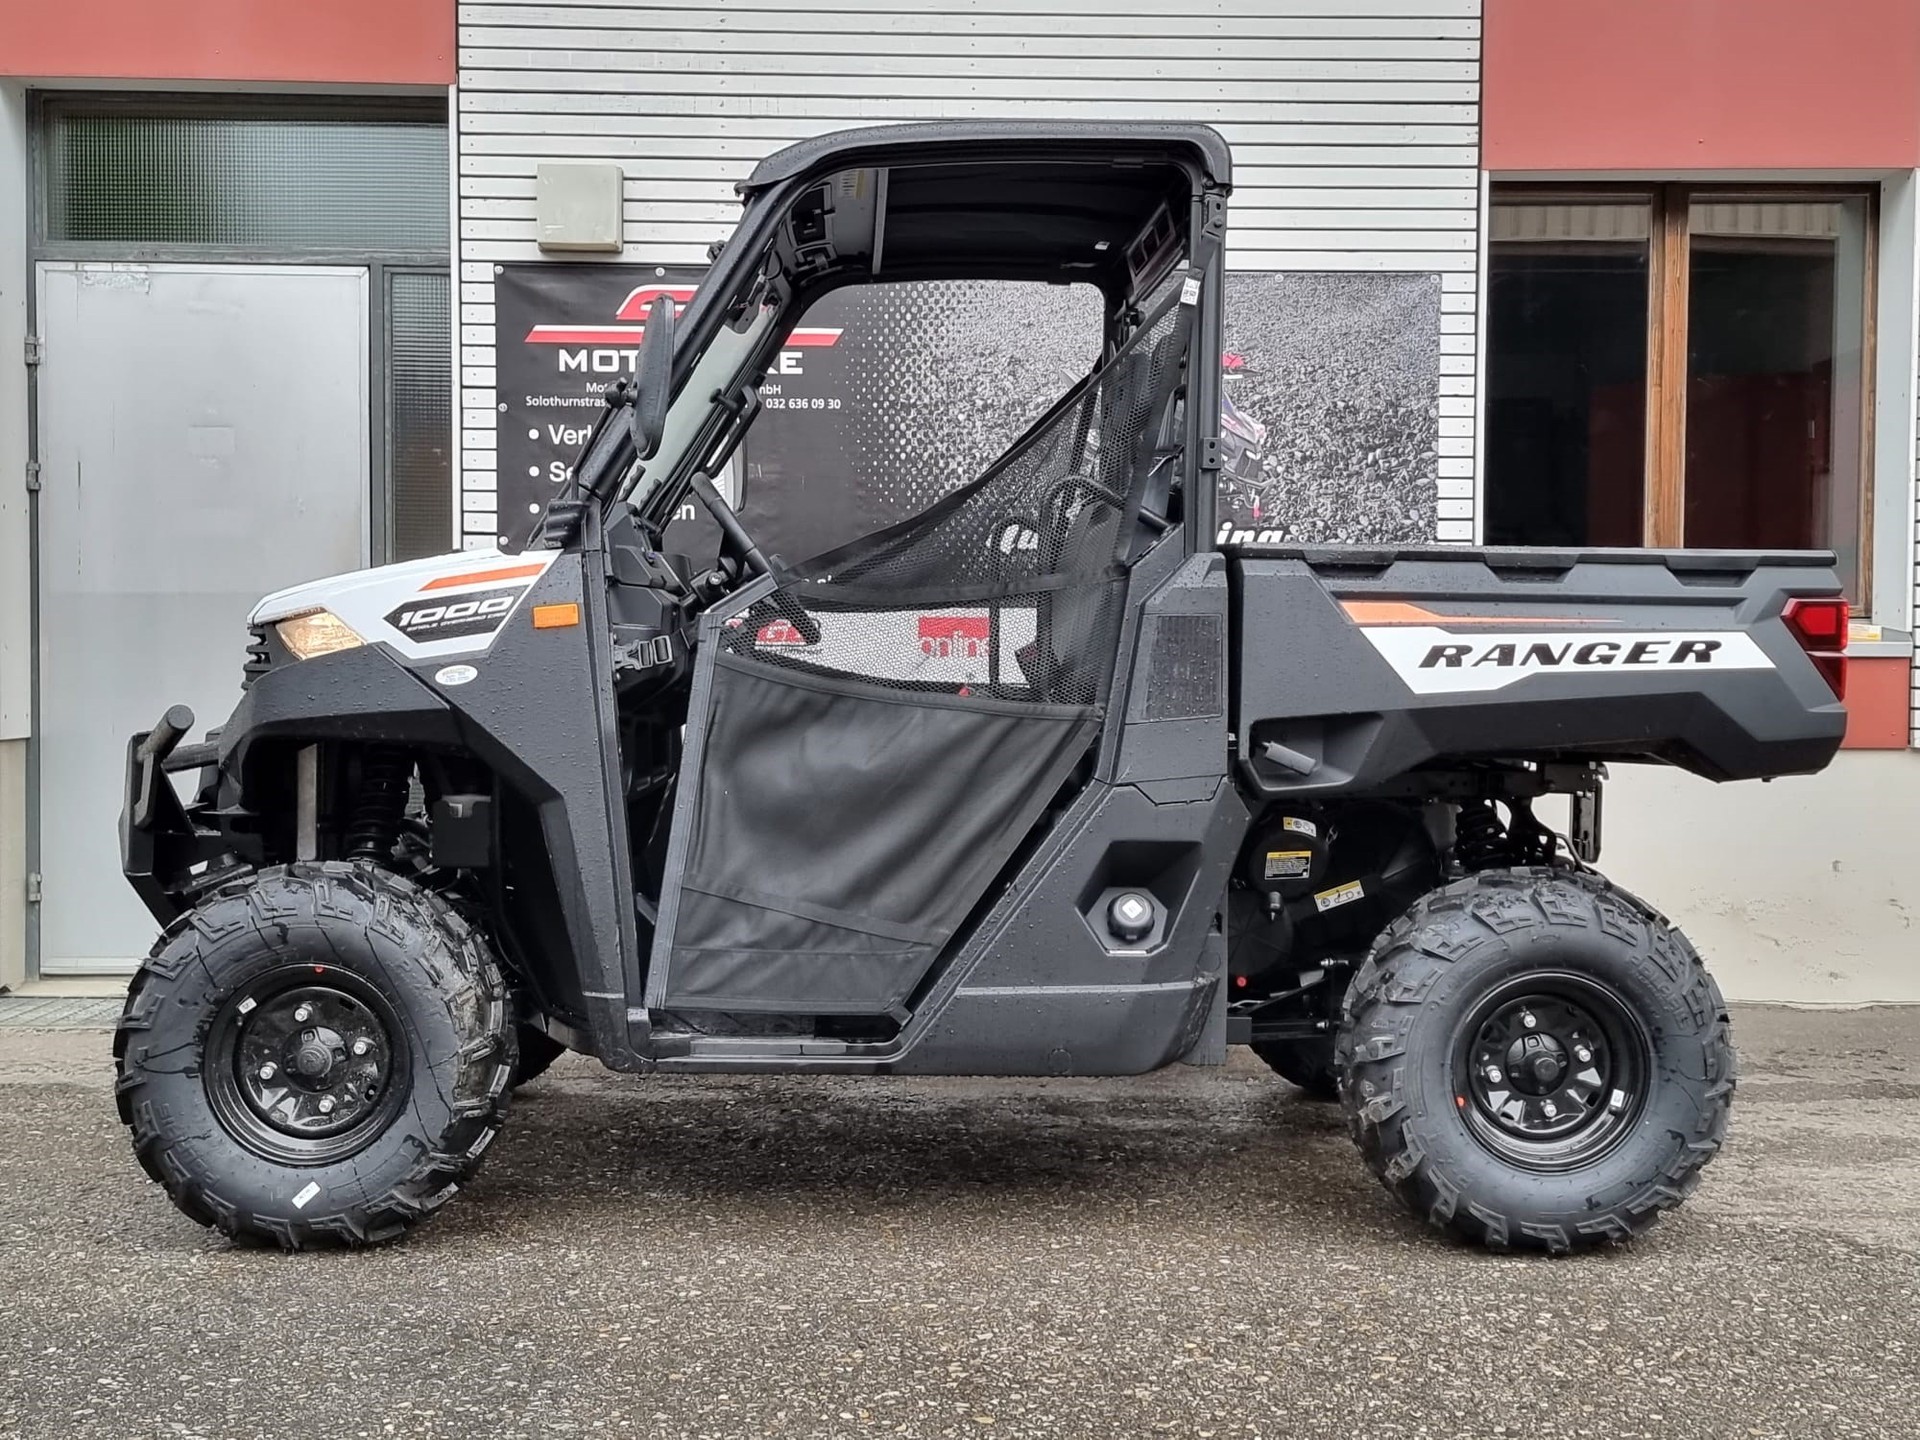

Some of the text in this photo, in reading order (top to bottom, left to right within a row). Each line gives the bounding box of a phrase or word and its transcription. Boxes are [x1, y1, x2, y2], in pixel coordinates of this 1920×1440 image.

[526, 395, 841, 409] Solothurnstras 032 636 09 30
[399, 596, 514, 627] 1000
[1418, 640, 1722, 668] RANGER
